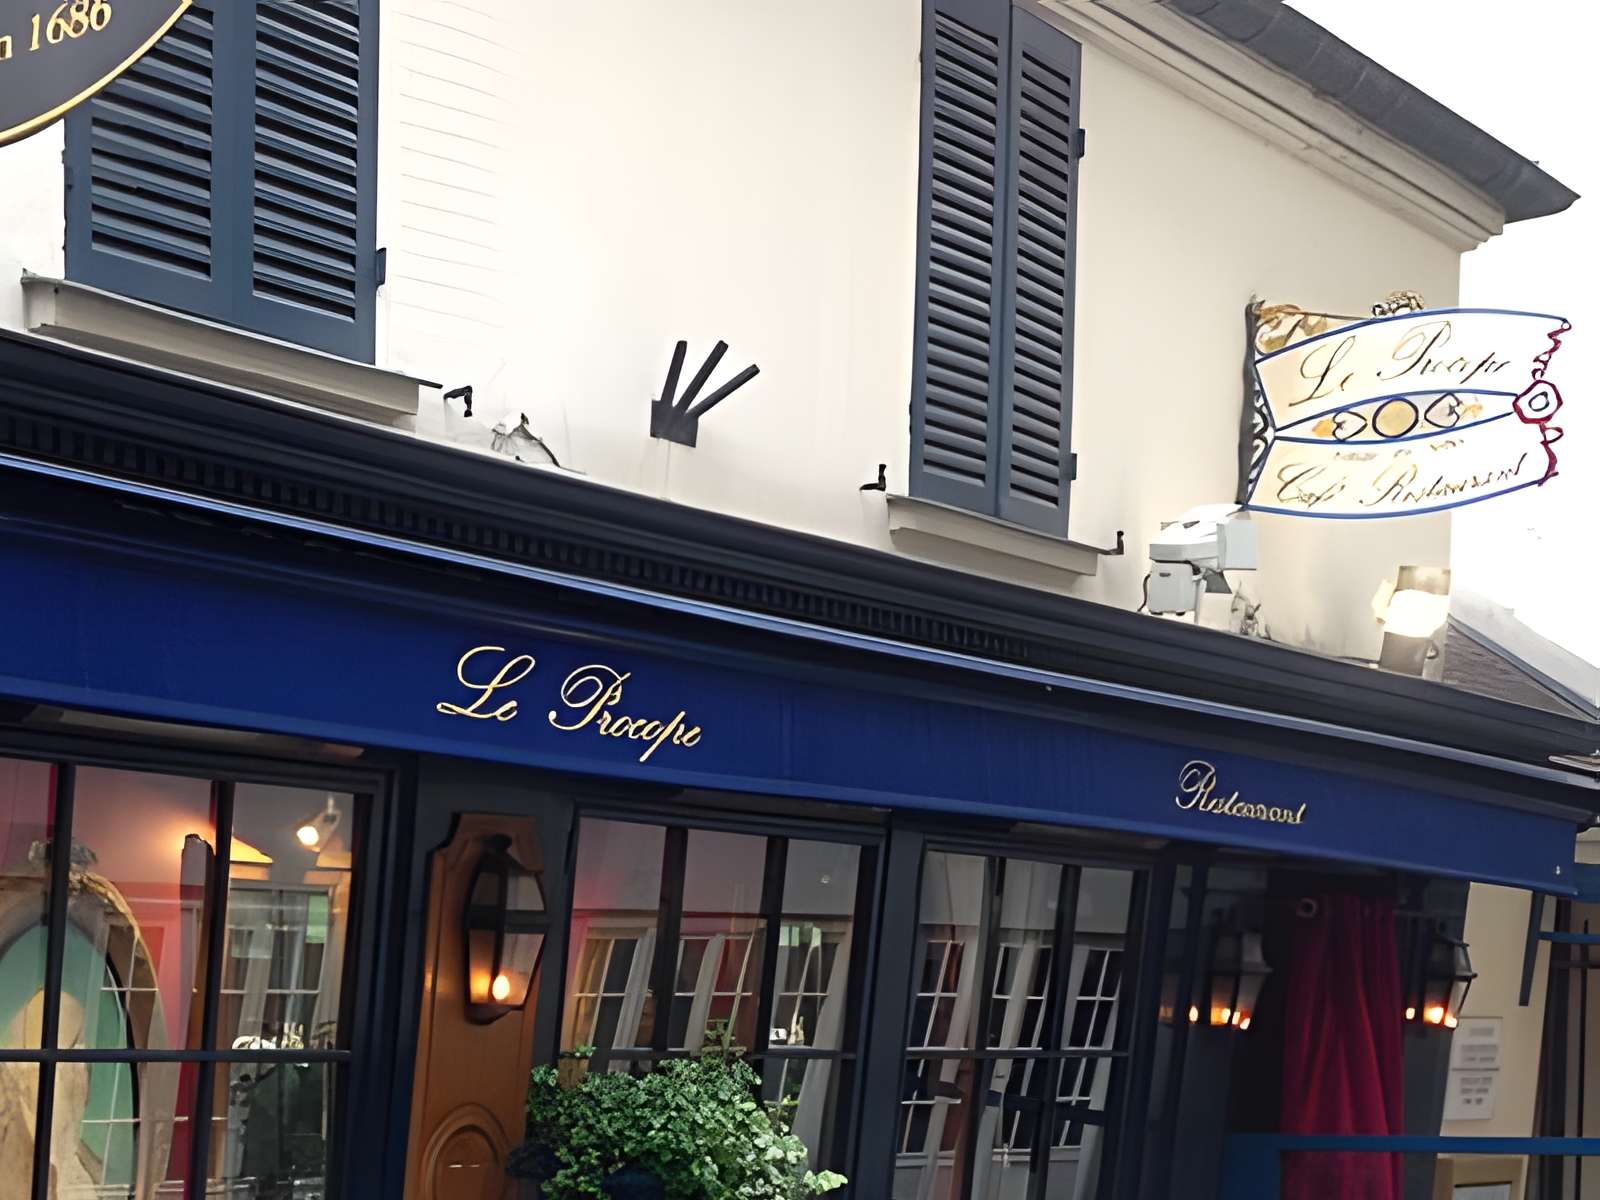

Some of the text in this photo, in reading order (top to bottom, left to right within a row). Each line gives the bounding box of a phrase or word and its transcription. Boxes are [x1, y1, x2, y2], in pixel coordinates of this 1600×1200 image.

[29, 0, 112, 51] 1686
[436, 645, 701, 762] Le Procope
